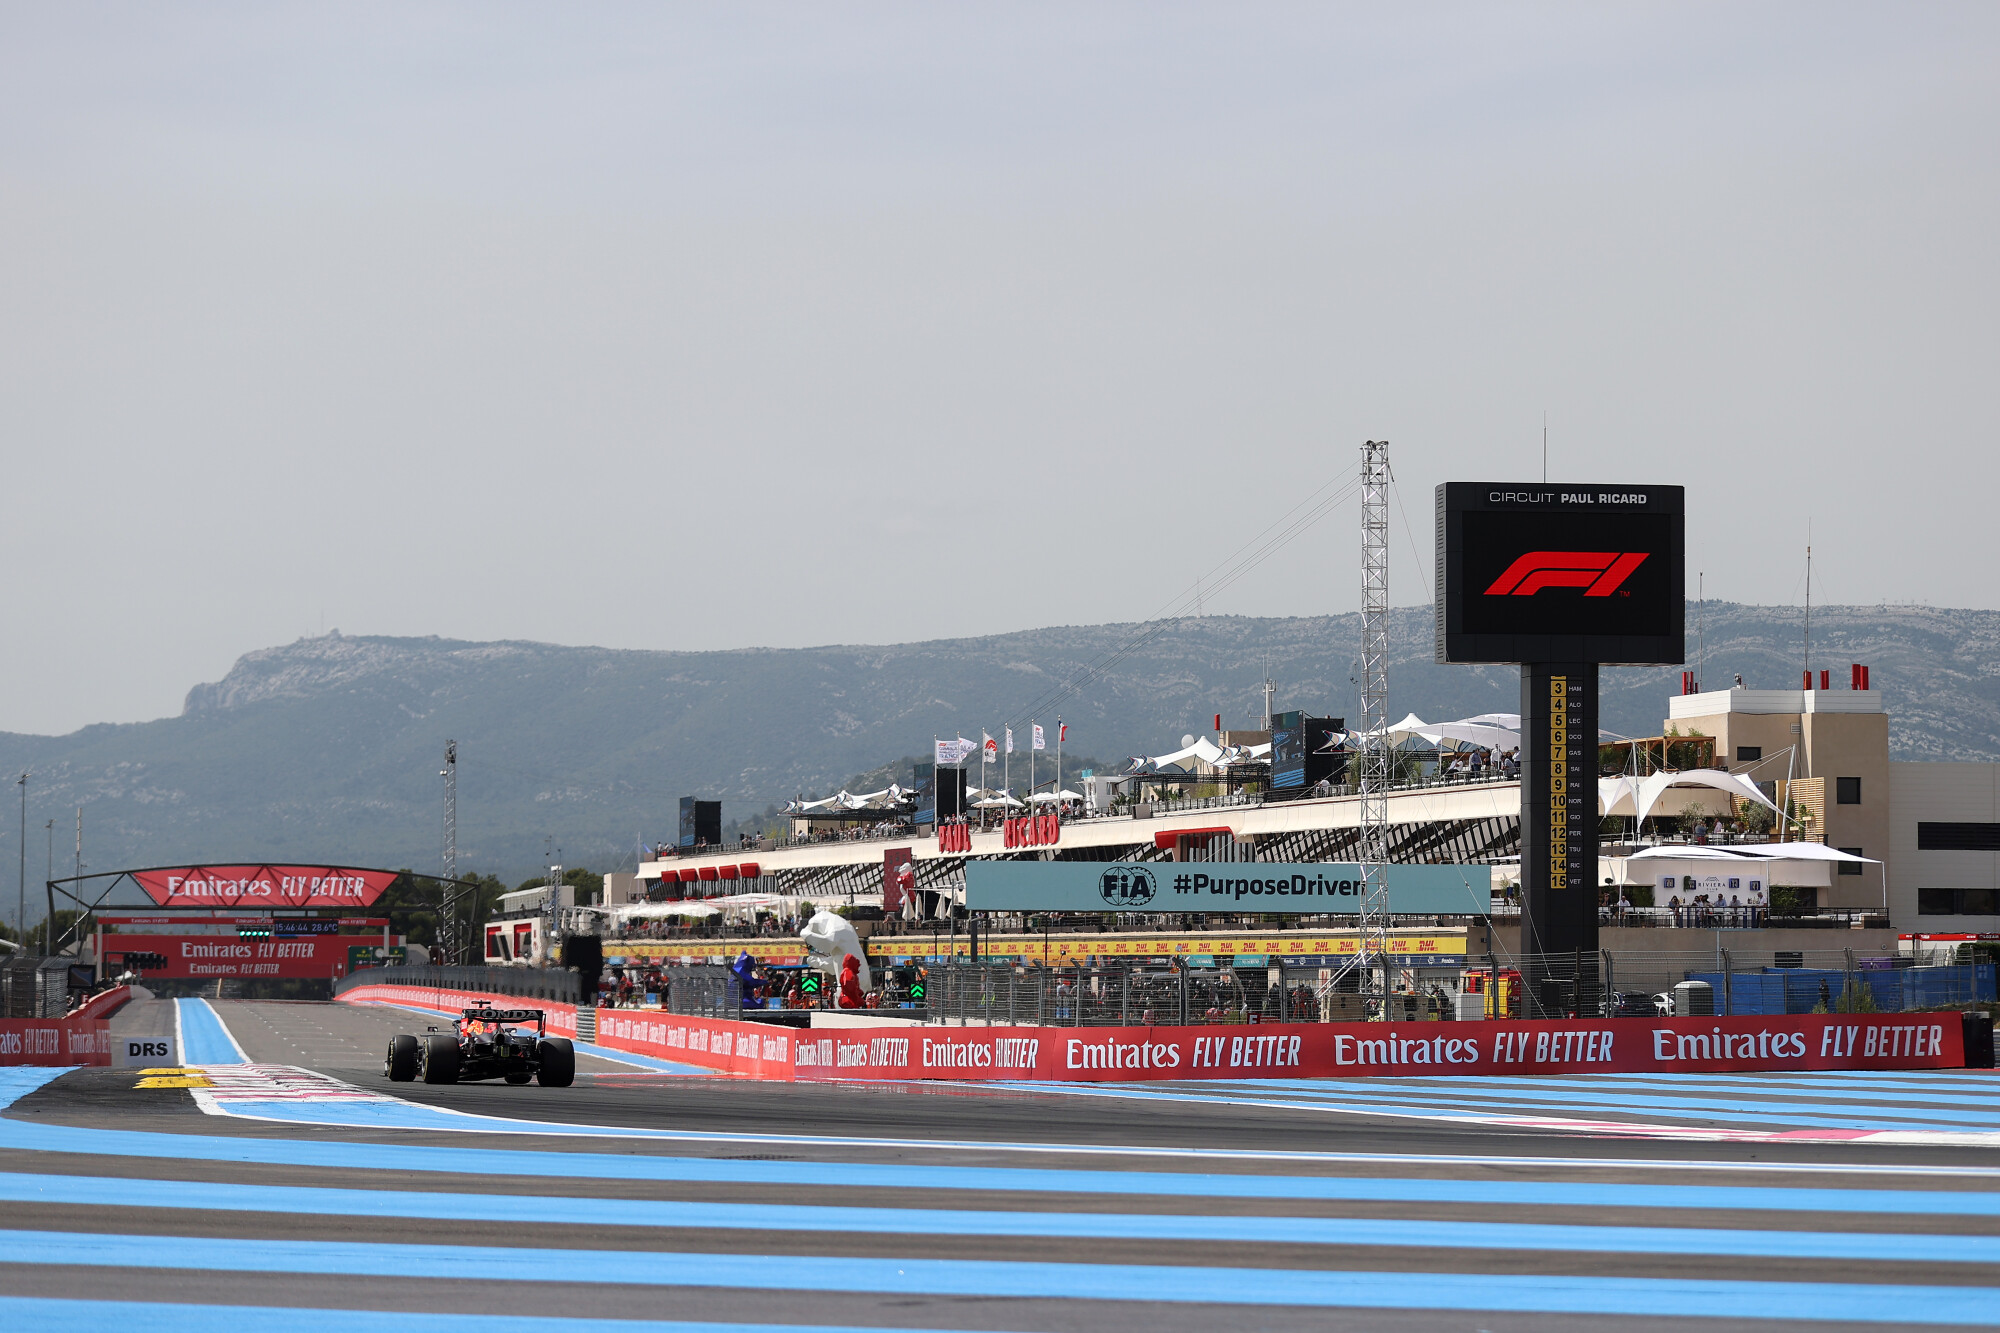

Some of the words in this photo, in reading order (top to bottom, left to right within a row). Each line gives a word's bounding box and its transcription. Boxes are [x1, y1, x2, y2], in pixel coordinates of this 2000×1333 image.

[1489, 492, 1554, 503] CIRCUIT
[1560, 494, 1594, 504] PAUL
[1599, 494, 1647, 504] RICARD
[1555, 683, 1562, 693] 3
[1555, 699, 1562, 710] 4
[1555, 715, 1562, 726] 5
[1555, 731, 1562, 742] 6
[1555, 747, 1562, 758] 7
[1555, 763, 1562, 774] 8
[1555, 779, 1562, 790] 9
[1552, 795, 1565, 806] 10
[1552, 811, 1564, 822] 11
[939, 824, 971, 852] PAUL
[1004, 816, 1060, 848] RICARD
[1552, 828, 1565, 838] 12
[1552, 844, 1565, 854] 13
[1552, 860, 1565, 870] 14
[168, 875, 272, 897] Emirates
[281, 876, 307, 897] FLY
[310, 876, 364, 897] BETTER
[1552, 876, 1566, 887] 15
[275, 923, 308, 932] 15:46:44
[181, 942, 252, 958] Emirates
[258, 943, 275, 958] FLY
[277, 943, 315, 958] BETTER
[190, 963, 237, 974] Emirates
[241, 964, 253, 974] FLY
[254, 964, 280, 974] BETTER
[467, 1010, 540, 1018] HONDA
[35, 1028, 60, 1054] BETTER
[129, 1042, 168, 1057] DRS
[837, 1038, 868, 1067] Emirates
[879, 1038, 909, 1067] BETTER
[922, 1037, 992, 1068] Emirates
[1066, 1037, 1180, 1069] Emirates
[1192, 1036, 1226, 1068] FLY
[1230, 1035, 1302, 1067] BETTER
[1334, 1032, 1480, 1066] Emirates
[1492, 1032, 1530, 1063] FLY
[1535, 1030, 1614, 1063] BETTER
[1652, 1026, 1806, 1061] Emirates
[1820, 1025, 1860, 1057] FLY
[1863, 1025, 1942, 1057] BETTER
